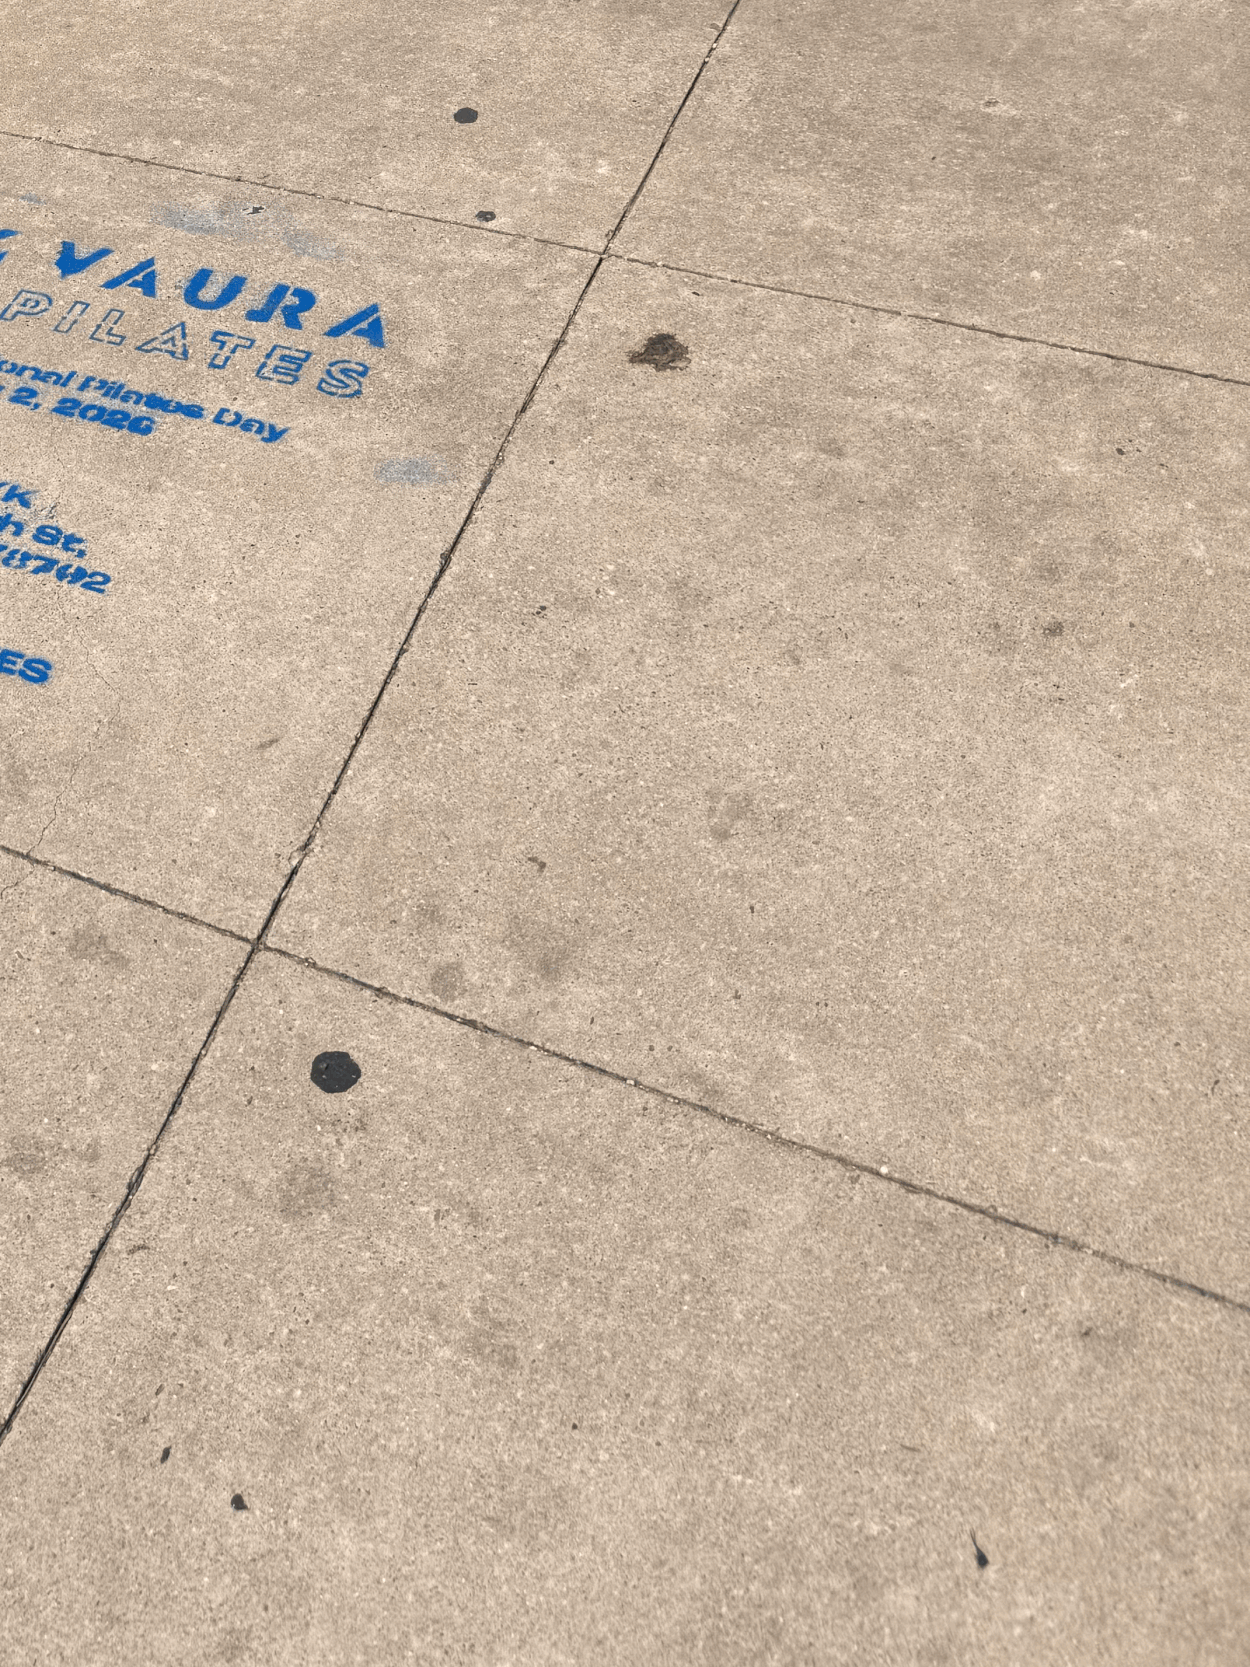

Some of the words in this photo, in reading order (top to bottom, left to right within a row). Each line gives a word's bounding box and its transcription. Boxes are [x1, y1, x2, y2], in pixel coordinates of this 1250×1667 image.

[54, 239, 387, 349] VAURA
[8, 385, 43, 411] 2,
[50, 396, 157, 437] 2026
[77, 374, 206, 420] Pilates
[212, 406, 292, 444] Day
